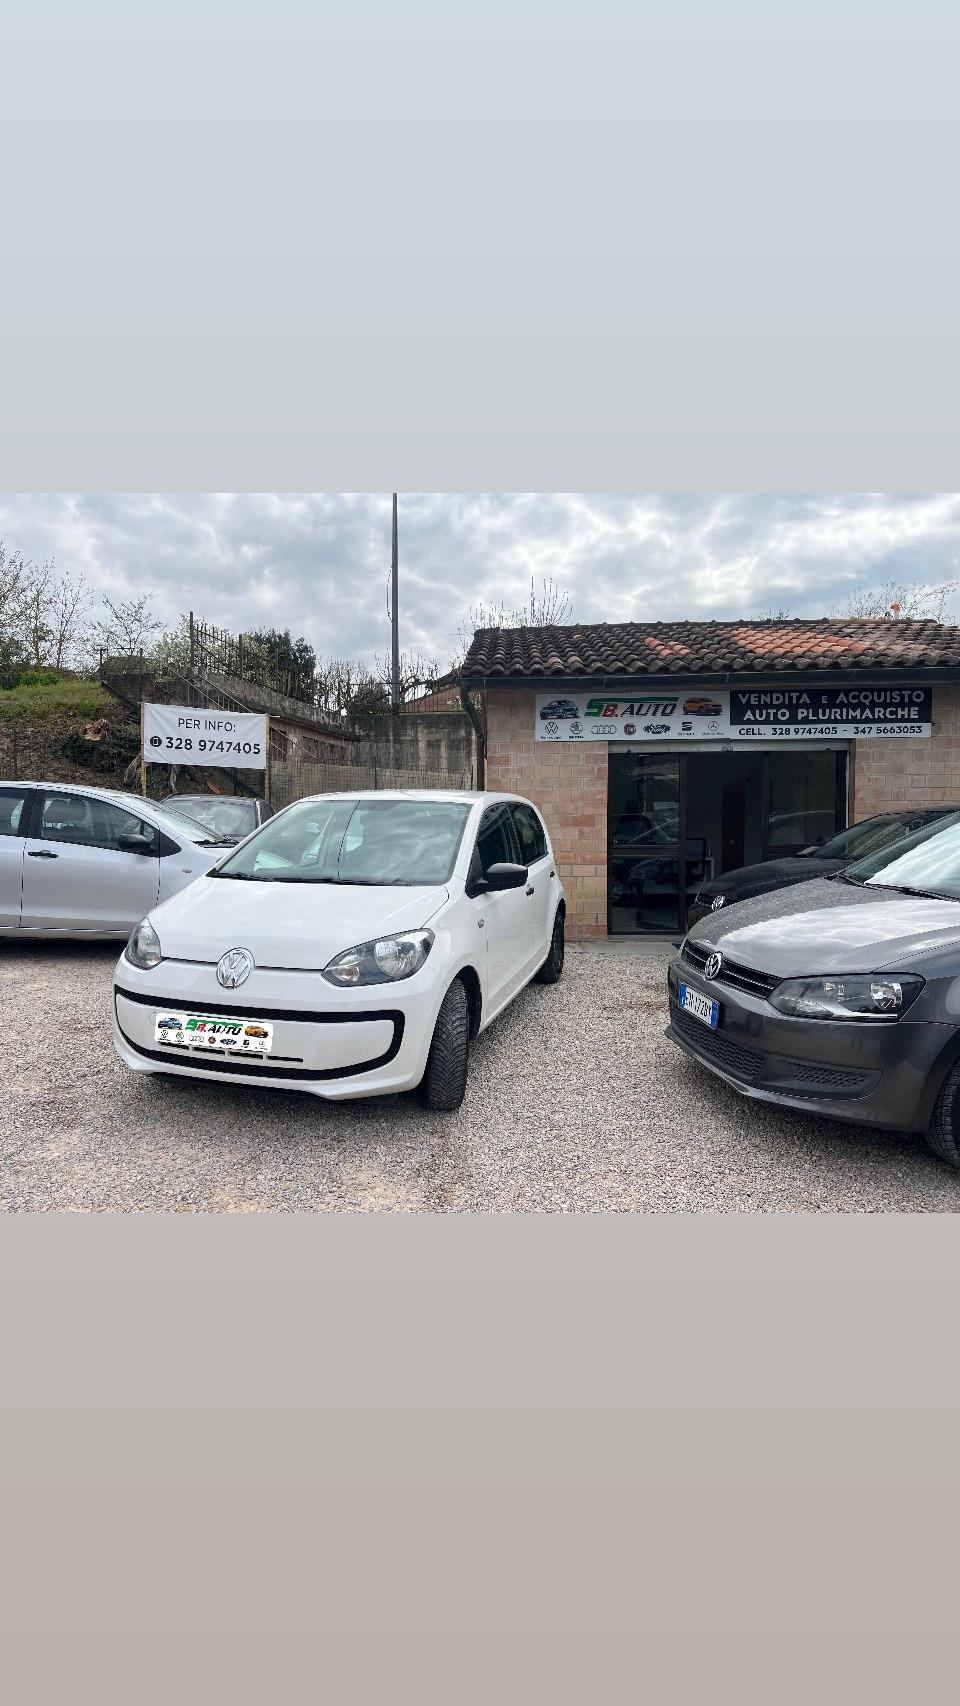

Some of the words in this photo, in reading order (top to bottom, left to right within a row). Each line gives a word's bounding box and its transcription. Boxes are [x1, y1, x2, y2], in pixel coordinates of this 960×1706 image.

[738, 693, 811, 705] VENDITA
[835, 691, 925, 706] ACQUISTO
[743, 709, 790, 721] AUTO
[797, 706, 919, 720] PLURIMARCHE
[178, 717, 201, 730] PER
[204, 720, 236, 733] INFO:
[738, 727, 766, 736] CELL.
[771, 727, 791, 736] 328
[793, 726, 838, 736] 9747405
[853, 726, 873, 735] 347
[875, 725, 922, 735] 5663053
[165, 736, 193, 751] 328
[198, 739, 261, 755] 9747405
